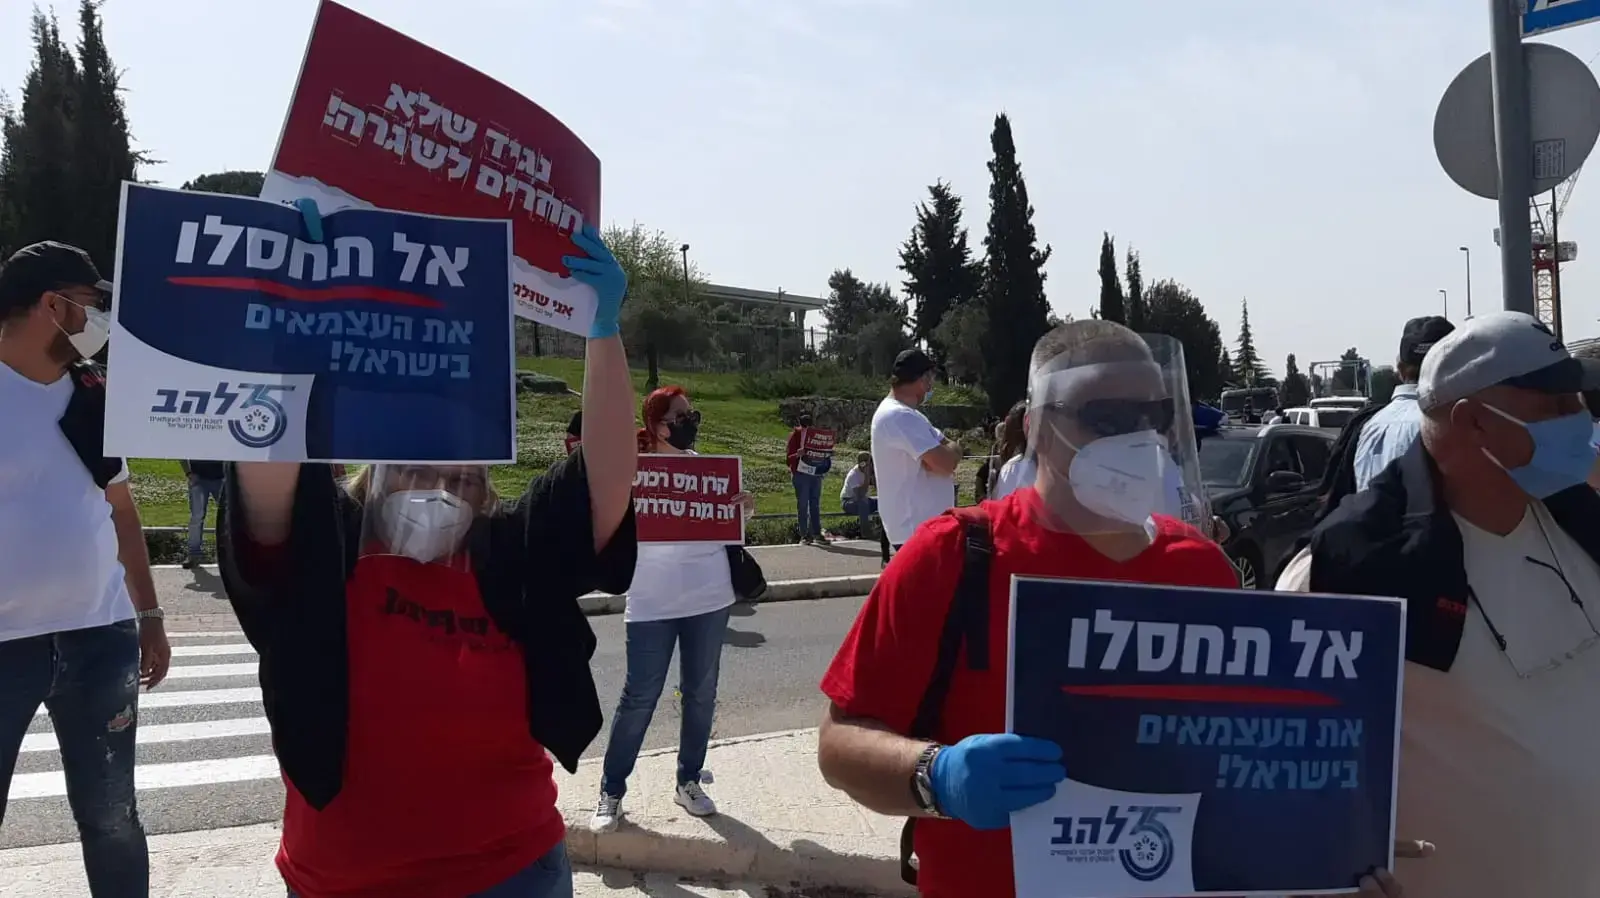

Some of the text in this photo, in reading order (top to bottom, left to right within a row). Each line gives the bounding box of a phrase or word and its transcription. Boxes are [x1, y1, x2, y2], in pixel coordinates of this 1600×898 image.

[384, 83, 552, 184] נגיד שלא
[323, 93, 583, 235] חוזרים לשגרה!
[174, 214, 470, 288] אל תחסלו
[513, 282, 550, 307] שולמ
[552, 300, 575, 320] אני
[244, 302, 475, 345] את העצמאים
[328, 340, 472, 380] בישראל!
[150, 381, 240, 416] להב
[672, 472, 698, 493] מס
[701, 474, 730, 496] קרן
[689, 501, 714, 521] מה
[716, 503, 736, 520] זה
[1067, 608, 1364, 679] אל תחסלו
[1136, 713, 1364, 748] את העצמאים
[1215, 754, 1359, 790] בישראל!
[1050, 805, 1129, 845] להב
